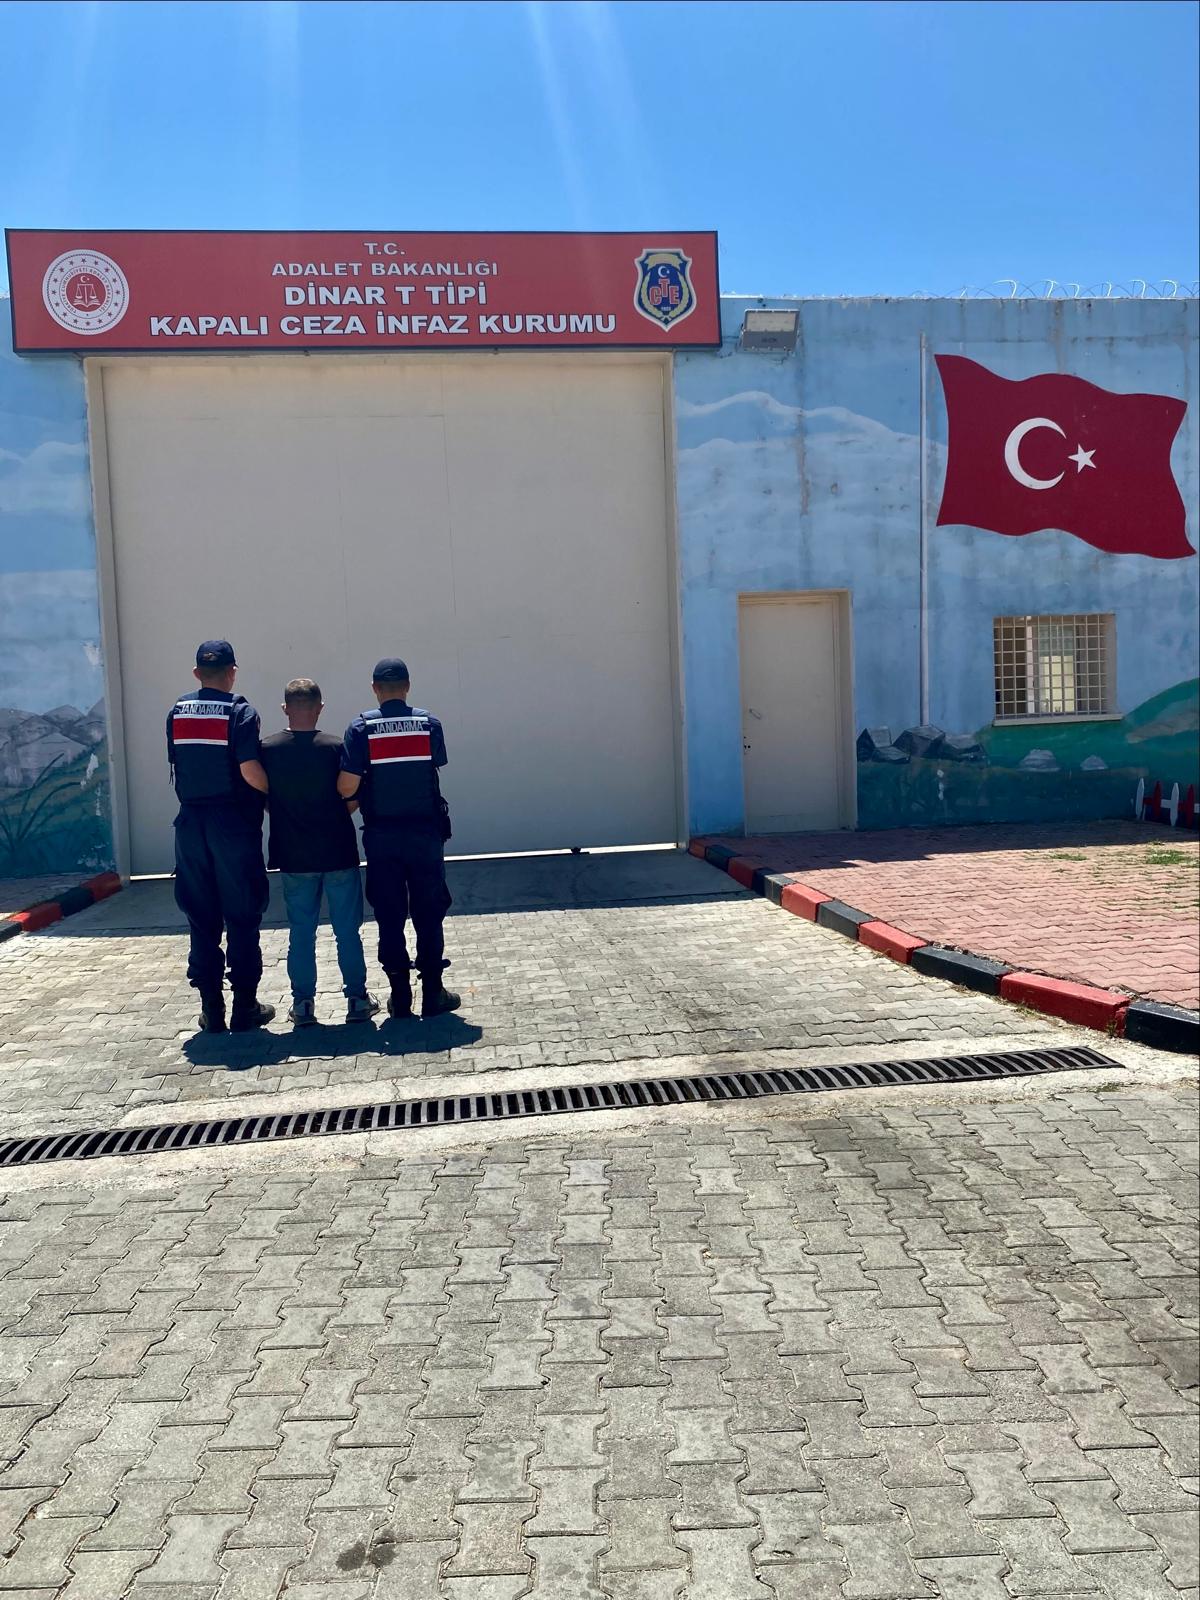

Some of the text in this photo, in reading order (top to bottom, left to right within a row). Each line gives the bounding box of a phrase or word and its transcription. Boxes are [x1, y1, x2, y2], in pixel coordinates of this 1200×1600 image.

[364, 242, 406, 256] T.C.
[271, 260, 499, 277] ADALET BAKANLIĞI
[284, 281, 488, 306] DİNAR T TİPİ
[150, 310, 617, 336] KAPALI CEZA İNFAZ KURUMU
[178, 703, 225, 715] JANDARMA
[374, 720, 424, 734] JANDARMA
